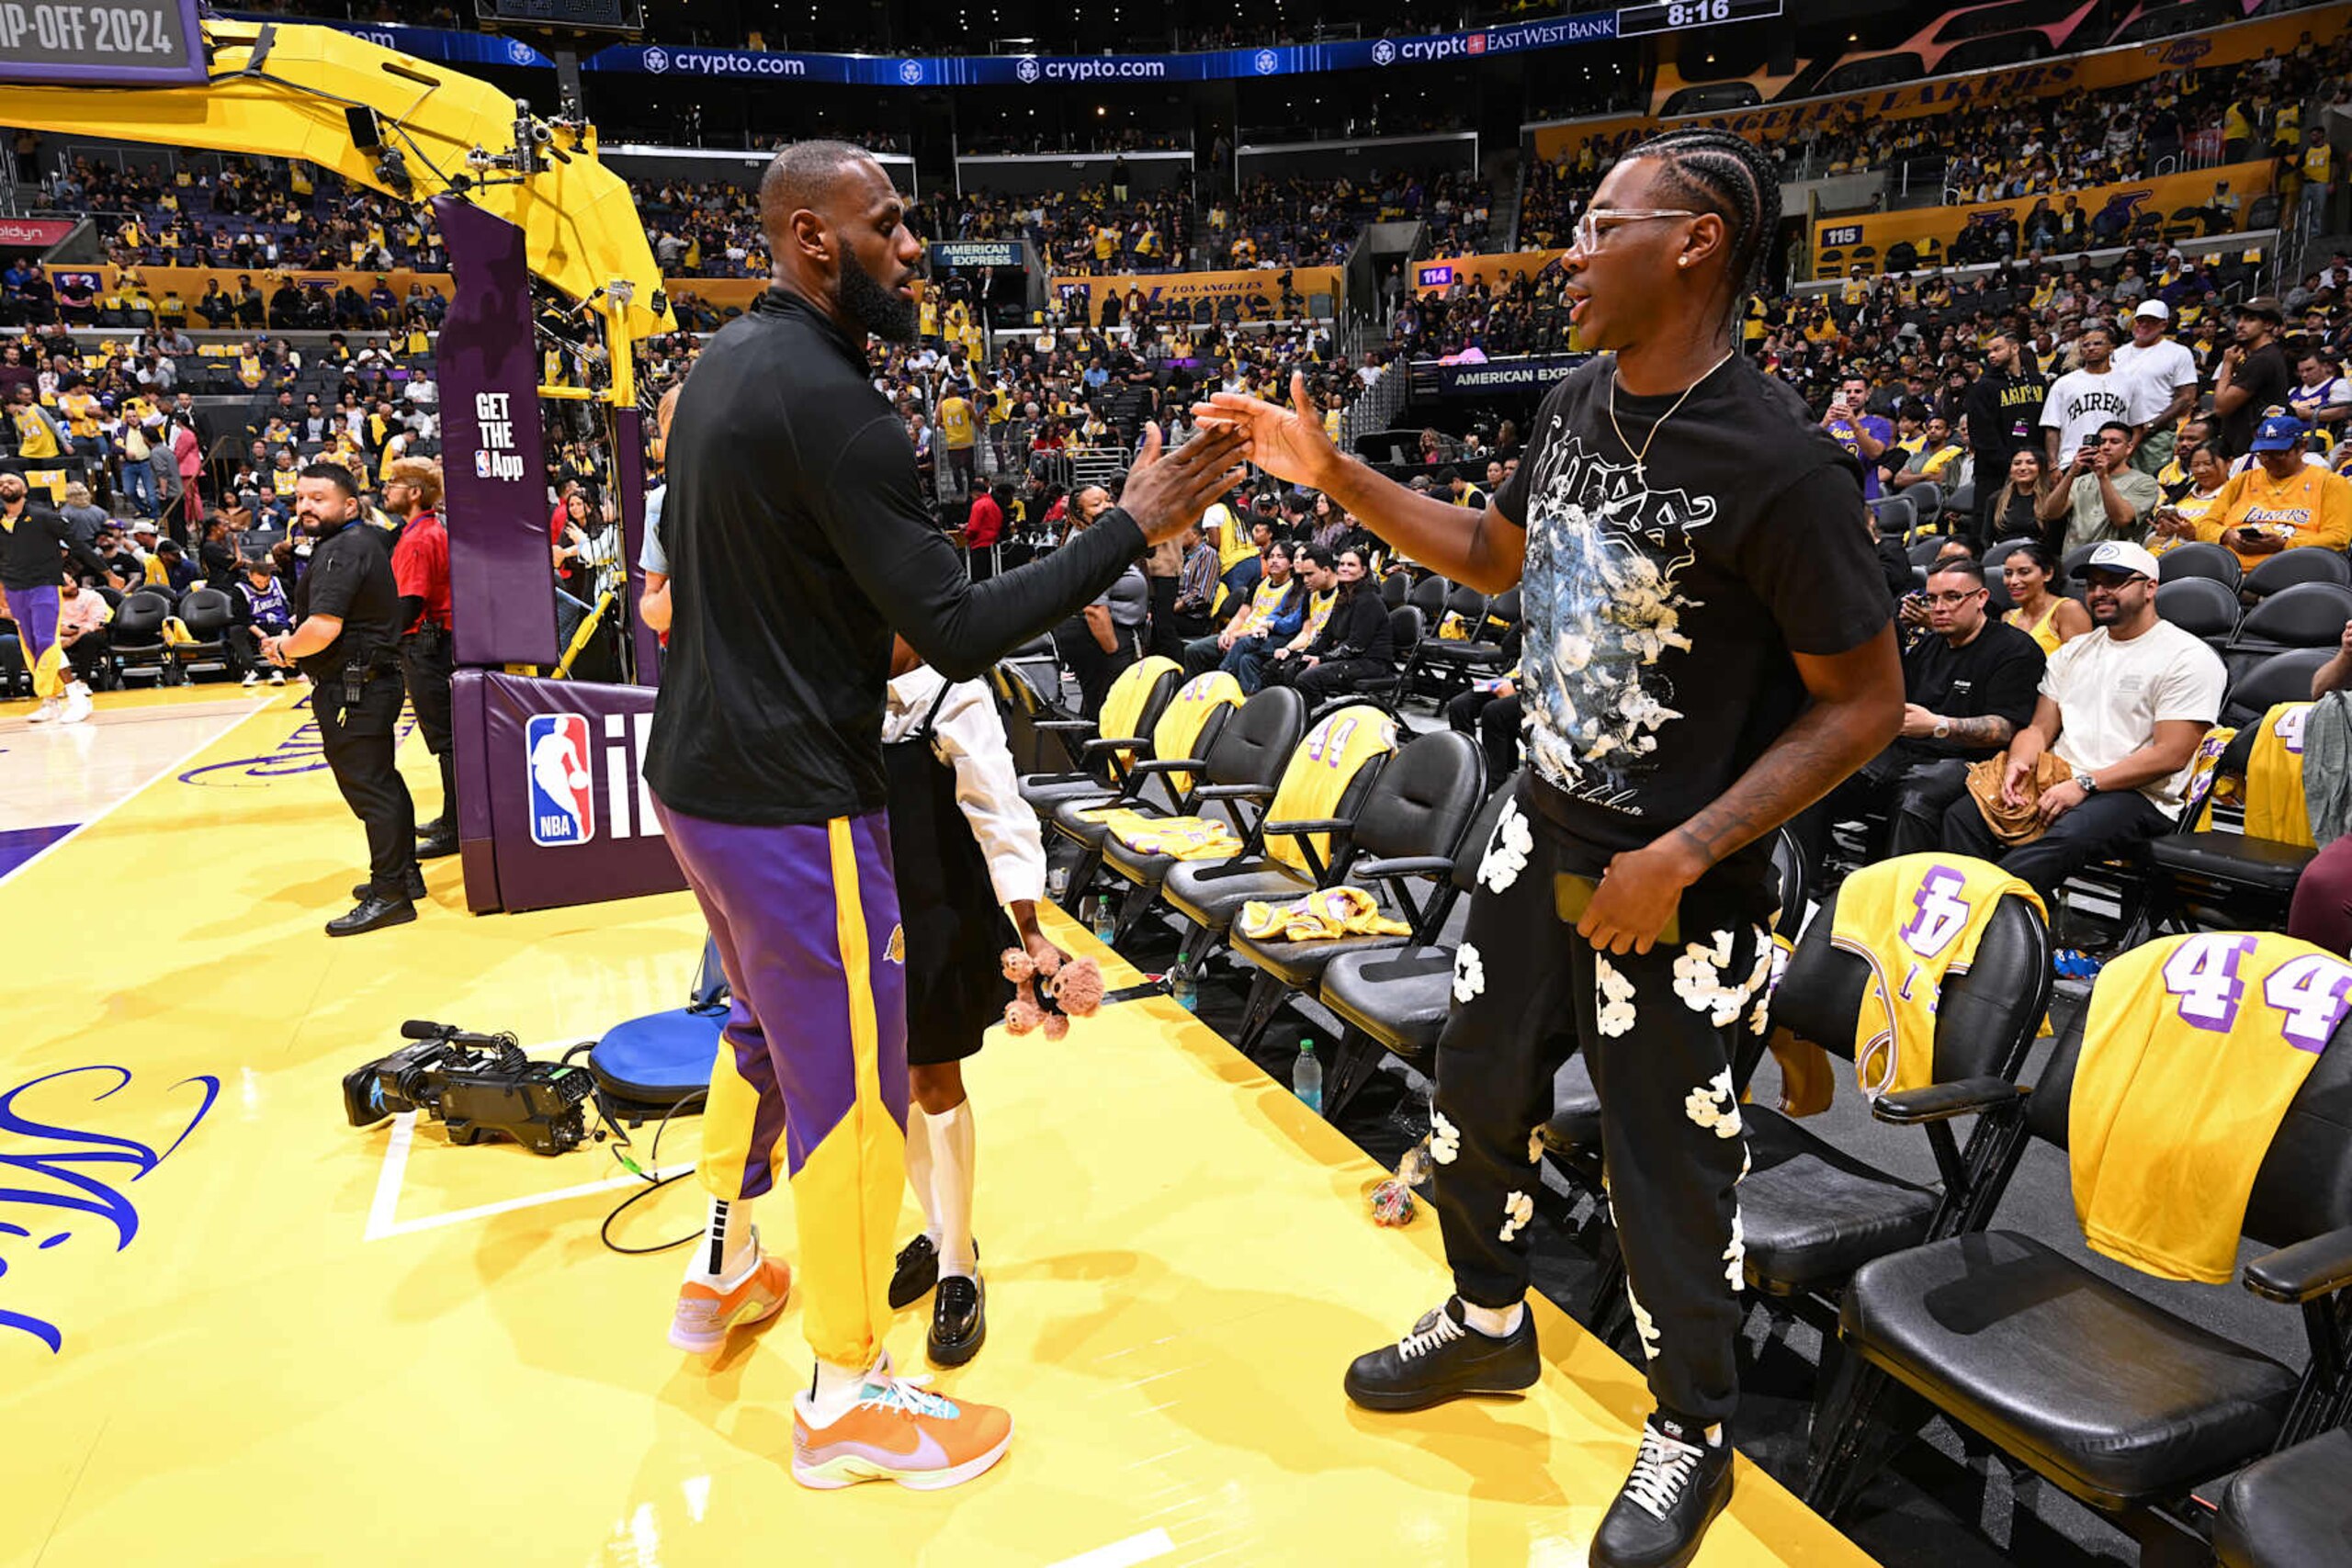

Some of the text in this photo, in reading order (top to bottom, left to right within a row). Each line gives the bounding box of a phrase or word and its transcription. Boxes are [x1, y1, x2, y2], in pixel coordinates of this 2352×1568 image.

[1668, 0, 1730, 26] 8:16
[90, 6, 174, 53] 2024
[675, 52, 806, 75] crypto.com
[1046, 59, 1165, 81] crypto.com
[1828, 228, 1856, 245] 115
[942, 244, 1010, 255] AMERICAN
[952, 255, 1012, 265] EXPRESS
[62, 275, 96, 290] 12
[1423, 269, 1448, 284] 114
[1455, 370, 1533, 386] AMERICAN
[476, 392, 510, 420] GET
[478, 422, 515, 448] THE
[492, 450, 525, 481] App
[2243, 506, 2312, 524] LAKERS
[1306, 715, 1358, 769] 44
[540, 815, 571, 838] NBA
[2162, 931, 2352, 1055] 44
